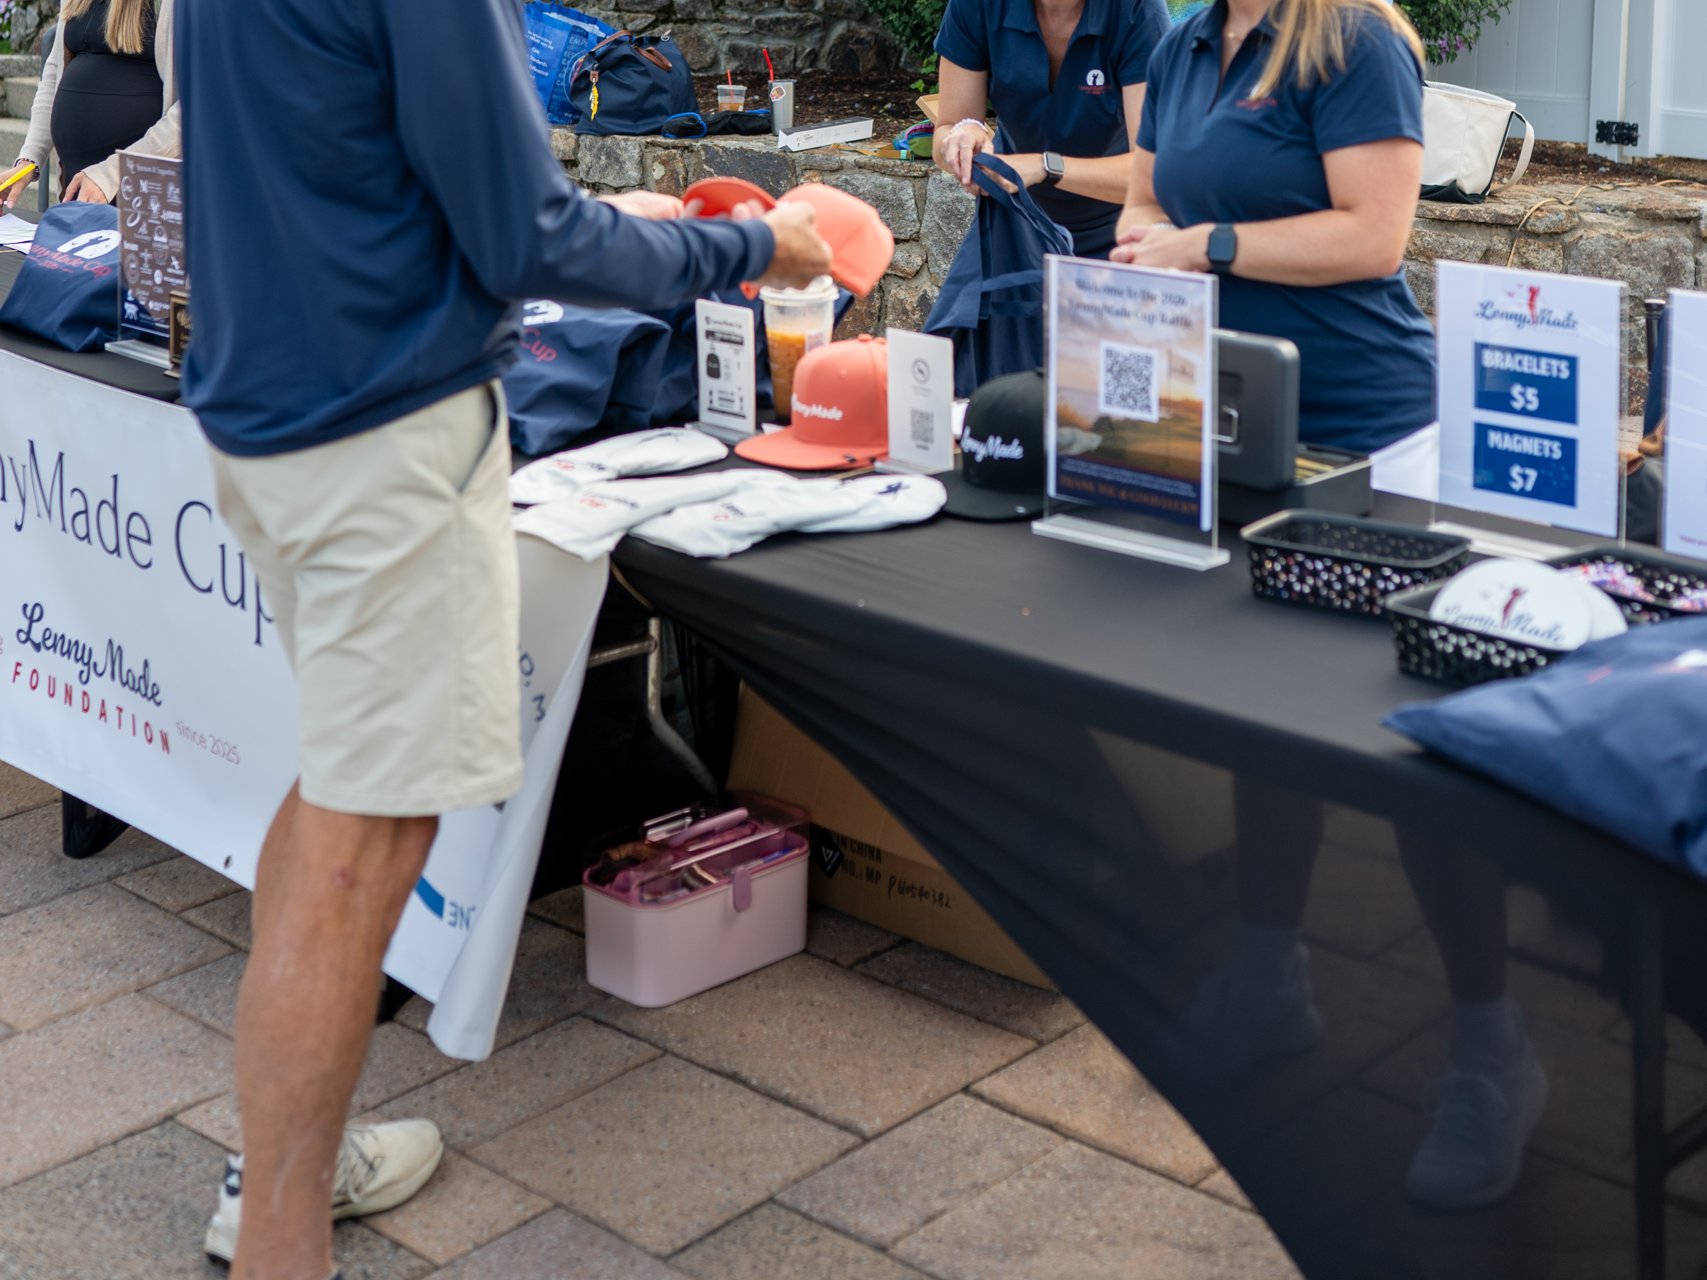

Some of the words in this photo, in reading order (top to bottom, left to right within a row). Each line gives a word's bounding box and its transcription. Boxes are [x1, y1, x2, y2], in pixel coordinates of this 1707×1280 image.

[1481, 348, 1570, 380] BRACELETS
[1509, 382, 1540, 411] $5
[1487, 429, 1562, 460] MAGNETS
[1508, 463, 1538, 492] $7
[16, 602, 163, 707] LennyMade
[12, 661, 171, 755] FOUNDATION
[175, 720, 208, 751] since
[209, 734, 241, 765] 2025
[850, 838, 882, 865] CHINA
